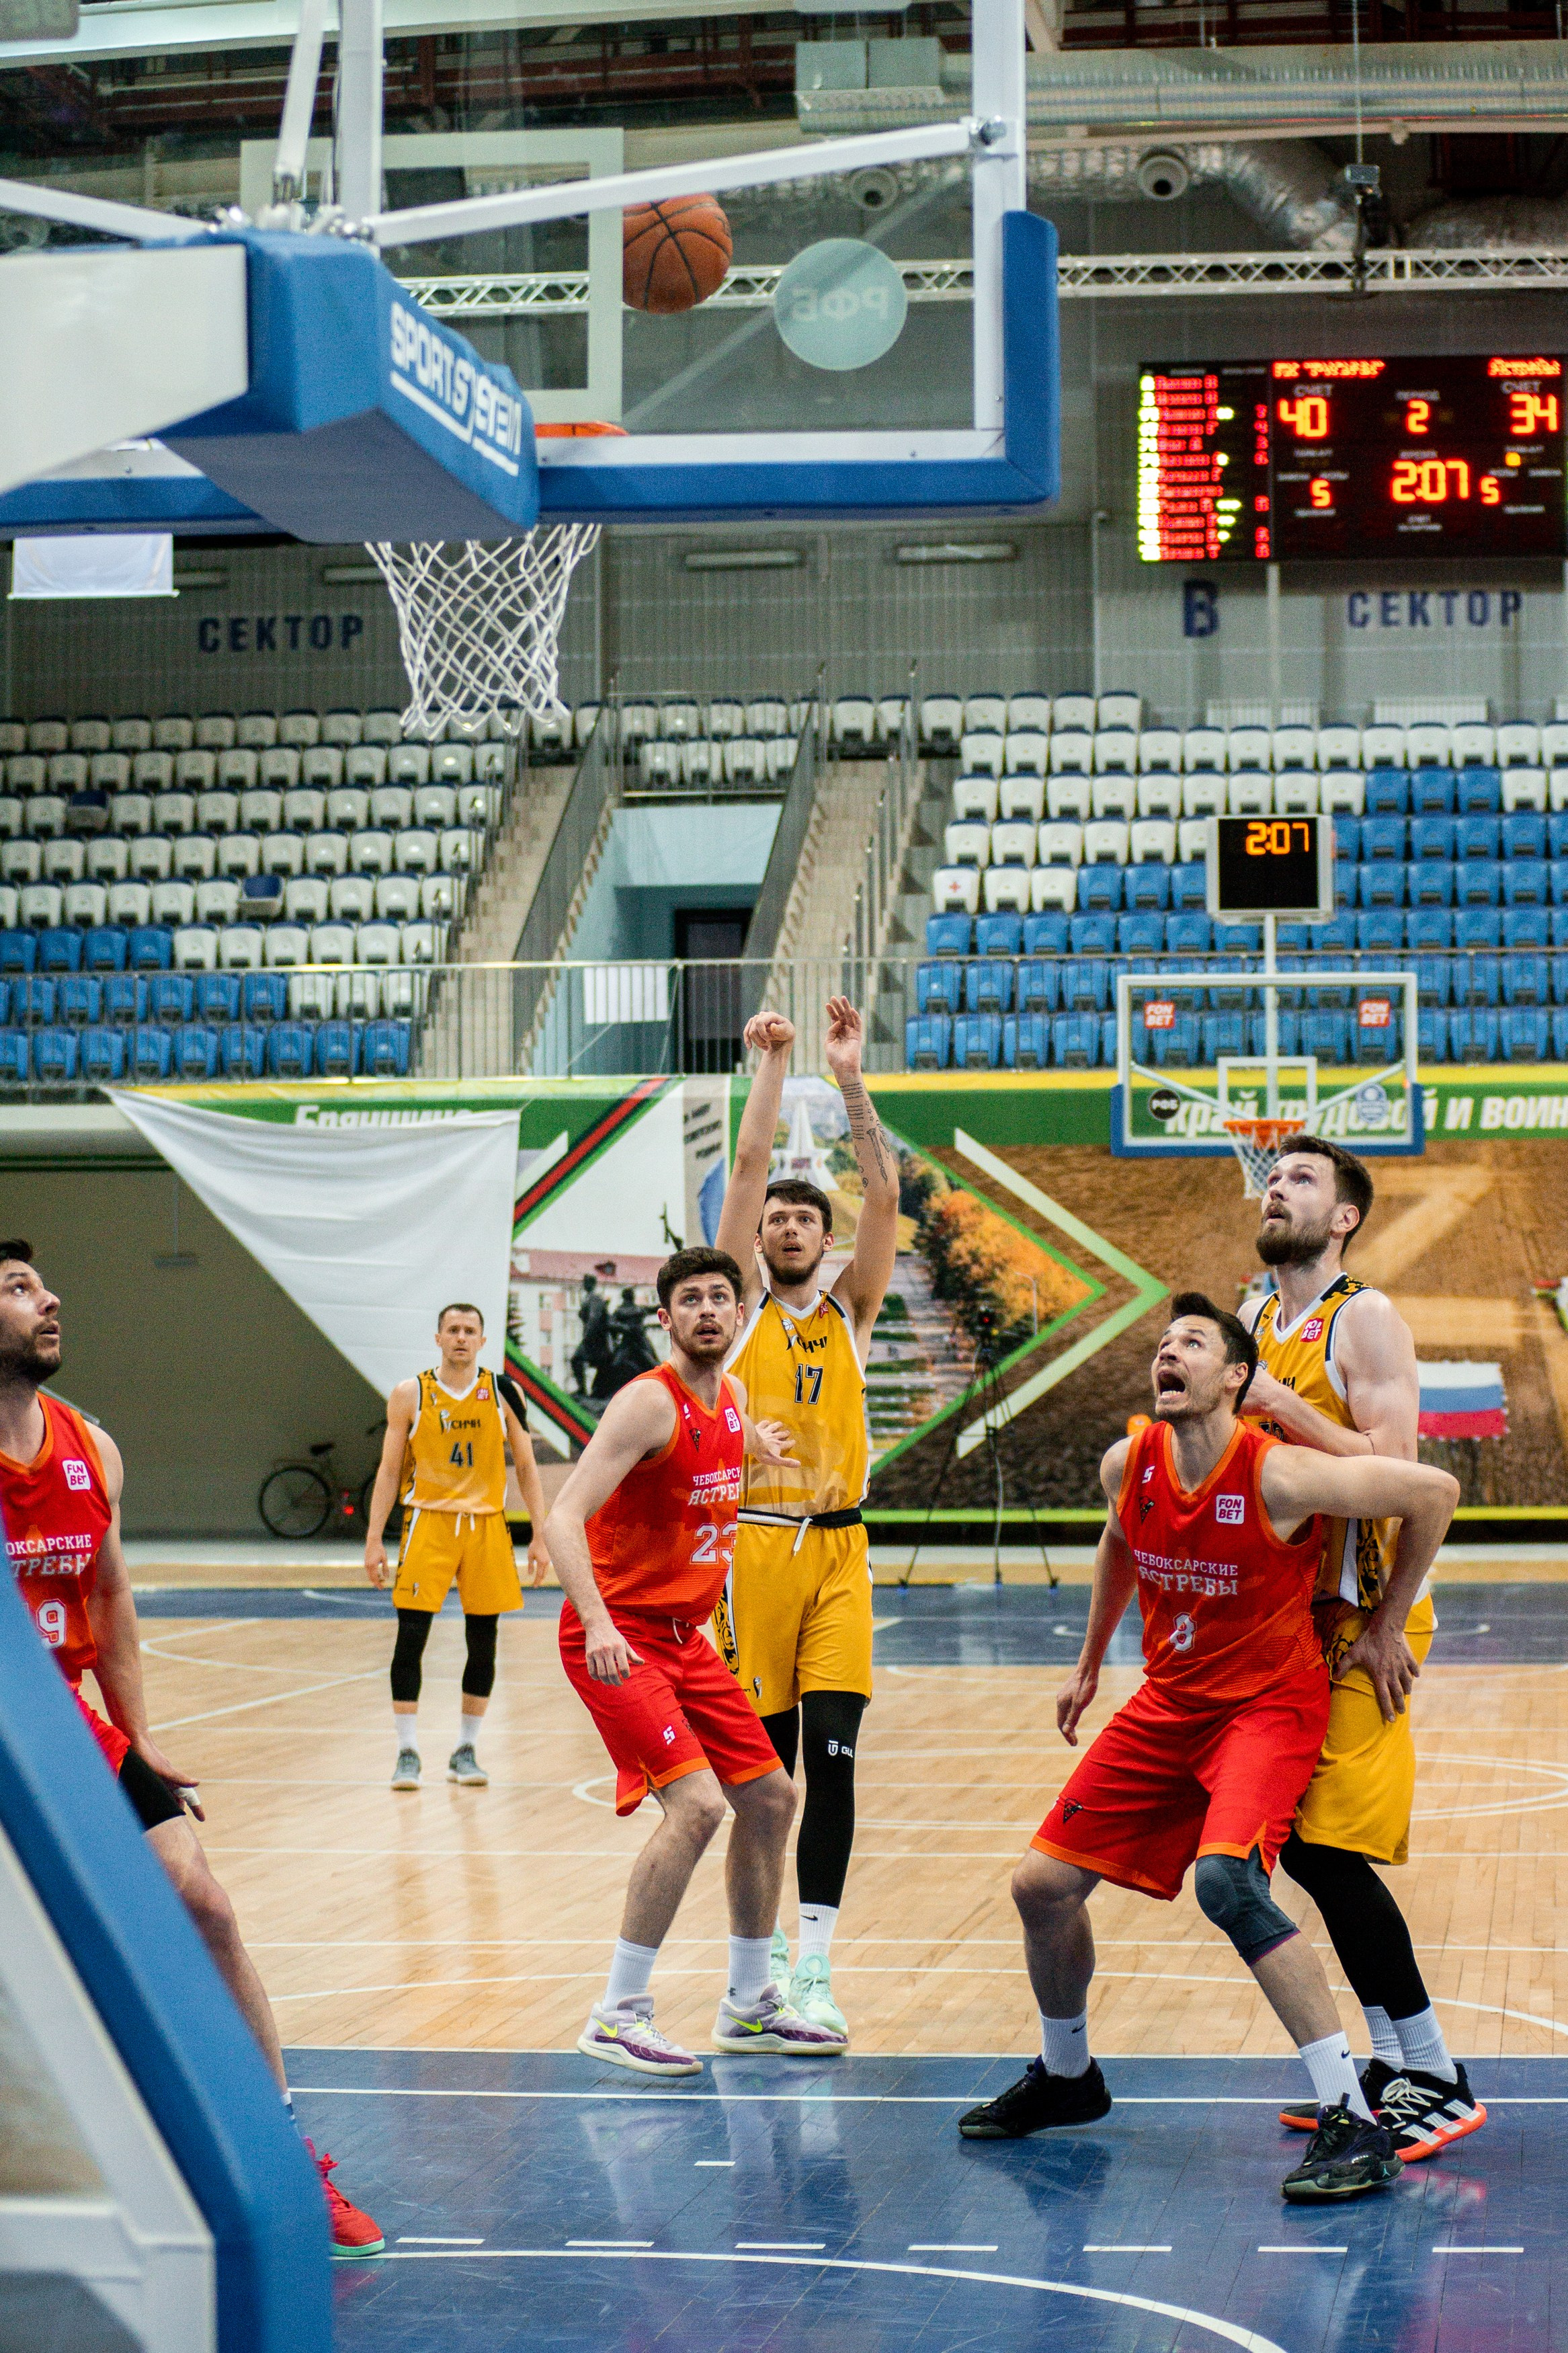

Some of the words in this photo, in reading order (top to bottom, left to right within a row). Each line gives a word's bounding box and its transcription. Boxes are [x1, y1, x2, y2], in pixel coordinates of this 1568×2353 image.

[1278, 397, 1328, 437] 40
[1407, 399, 1430, 433] 2
[1510, 393, 1559, 434] 34
[1392, 459, 1469, 502] 2:07
[1348, 590, 1522, 628] СЕКТОР
[199, 614, 364, 653] СЕКТОР
[1246, 822, 1309, 855] 2:07
[1145, 1014, 1173, 1026] BET
[1361, 1014, 1389, 1024] BET
[1444, 1096, 1474, 1129] и
[794, 1363, 824, 1404] 17
[449, 1441, 473, 1467] 41
[70, 1475, 86, 1485] BET
[1218, 1509, 1242, 1520] BET
[1219, 1499, 1241, 1509] FON
[690, 1521, 737, 1565] 23
[1134, 1549, 1238, 1577] ЧЕБОКСАРСКИЕ
[1138, 1565, 1237, 1597] ЯСТРЕБЫ
